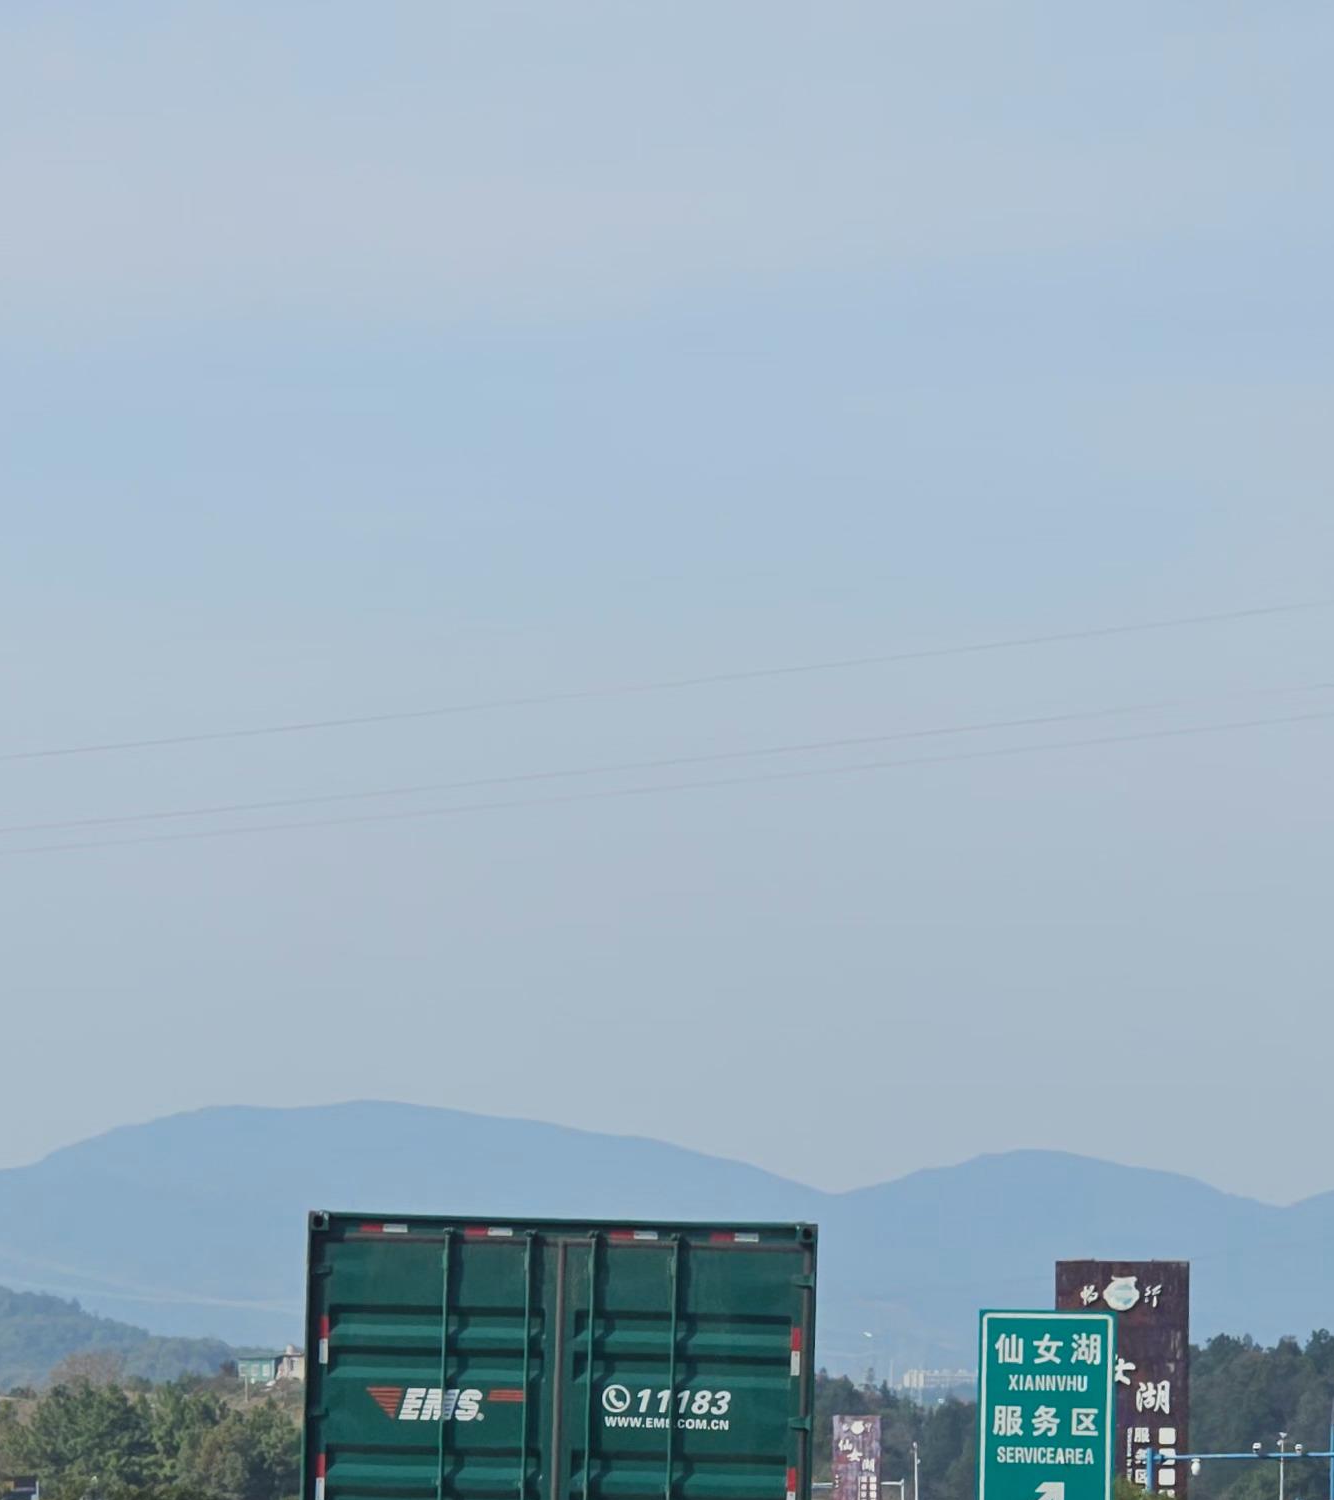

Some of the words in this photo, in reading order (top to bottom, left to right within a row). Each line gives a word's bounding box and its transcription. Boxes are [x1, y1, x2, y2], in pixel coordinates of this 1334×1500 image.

[994, 1333, 1102, 1365] 仙女湖
[1008, 1374, 1088, 1392] XIANNVHU
[398, 1387, 484, 1421] EMS
[637, 1388, 732, 1415] 11183
[992, 1405, 1099, 1437] 服务区
[996, 1446, 1095, 1465] SERVICEAREA
